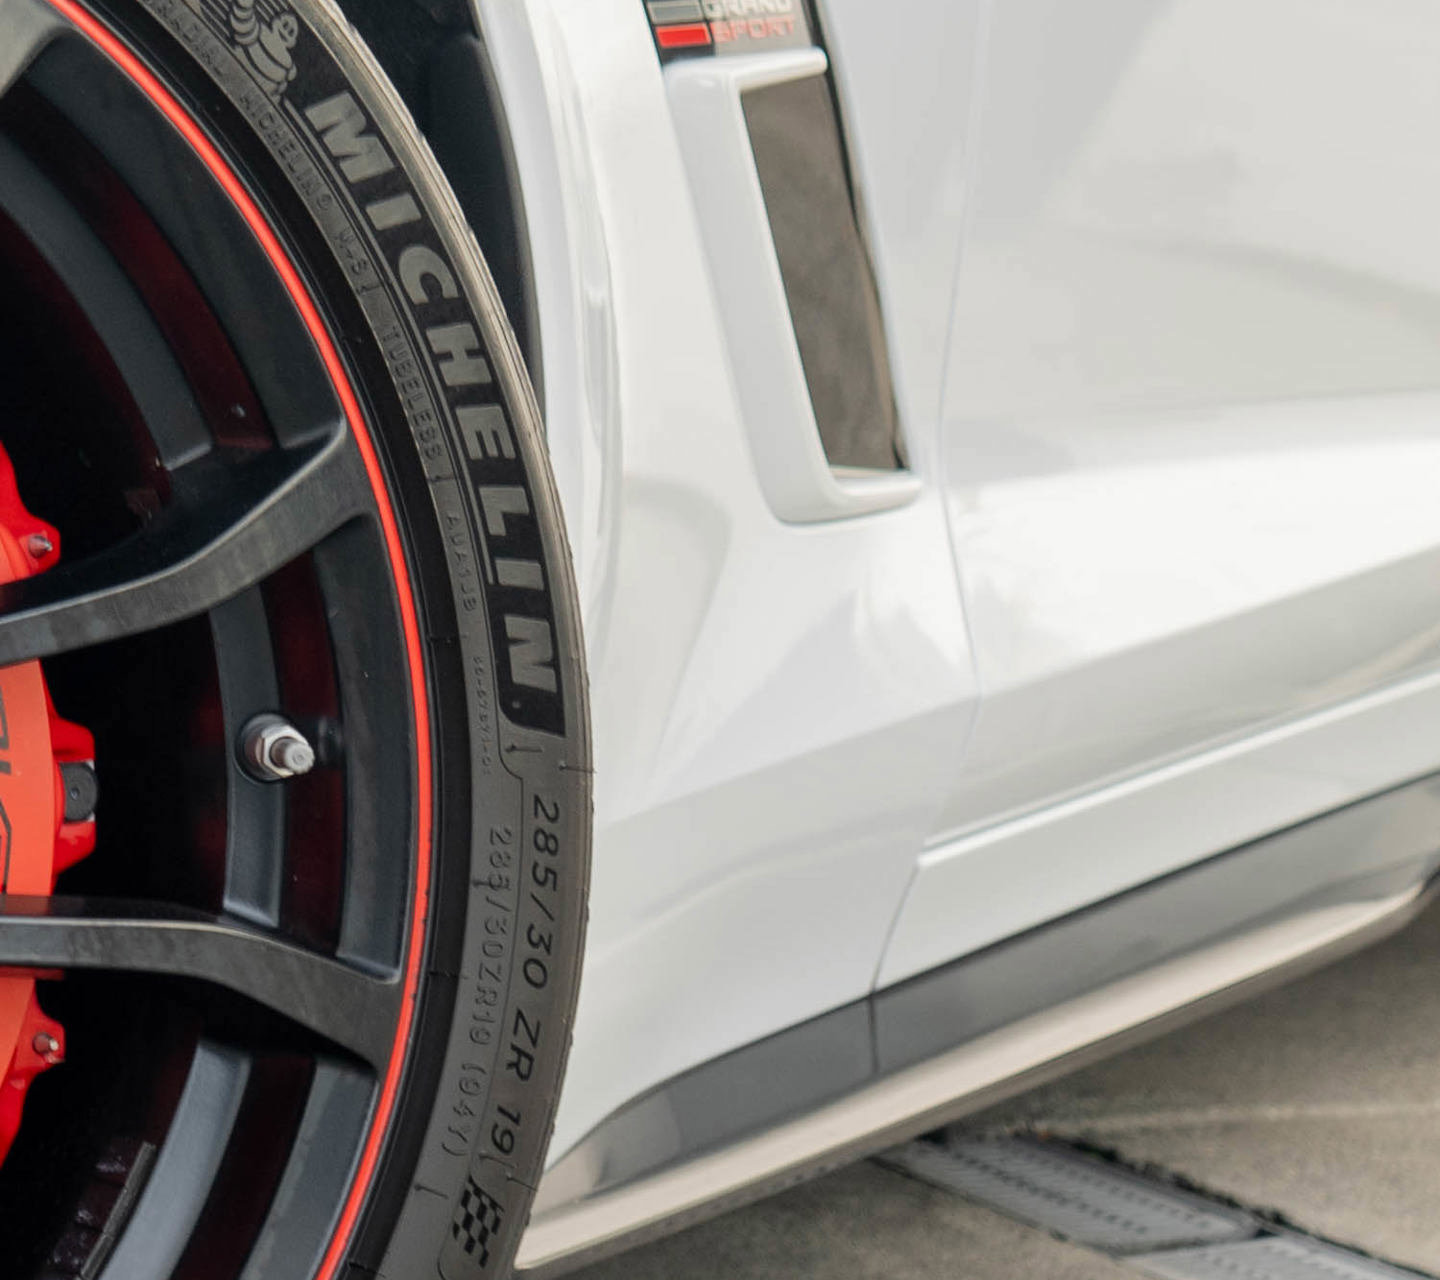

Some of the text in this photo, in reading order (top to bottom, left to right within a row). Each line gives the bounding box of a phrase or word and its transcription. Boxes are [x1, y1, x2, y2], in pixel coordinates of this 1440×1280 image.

[306, 92, 563, 703] MICHELIN
[380, 324, 443, 461] TUBELESS
[466, 825, 513, 1047] 285/30ZR19
[484, 792, 559, 1157] 285/30 ZR 19
